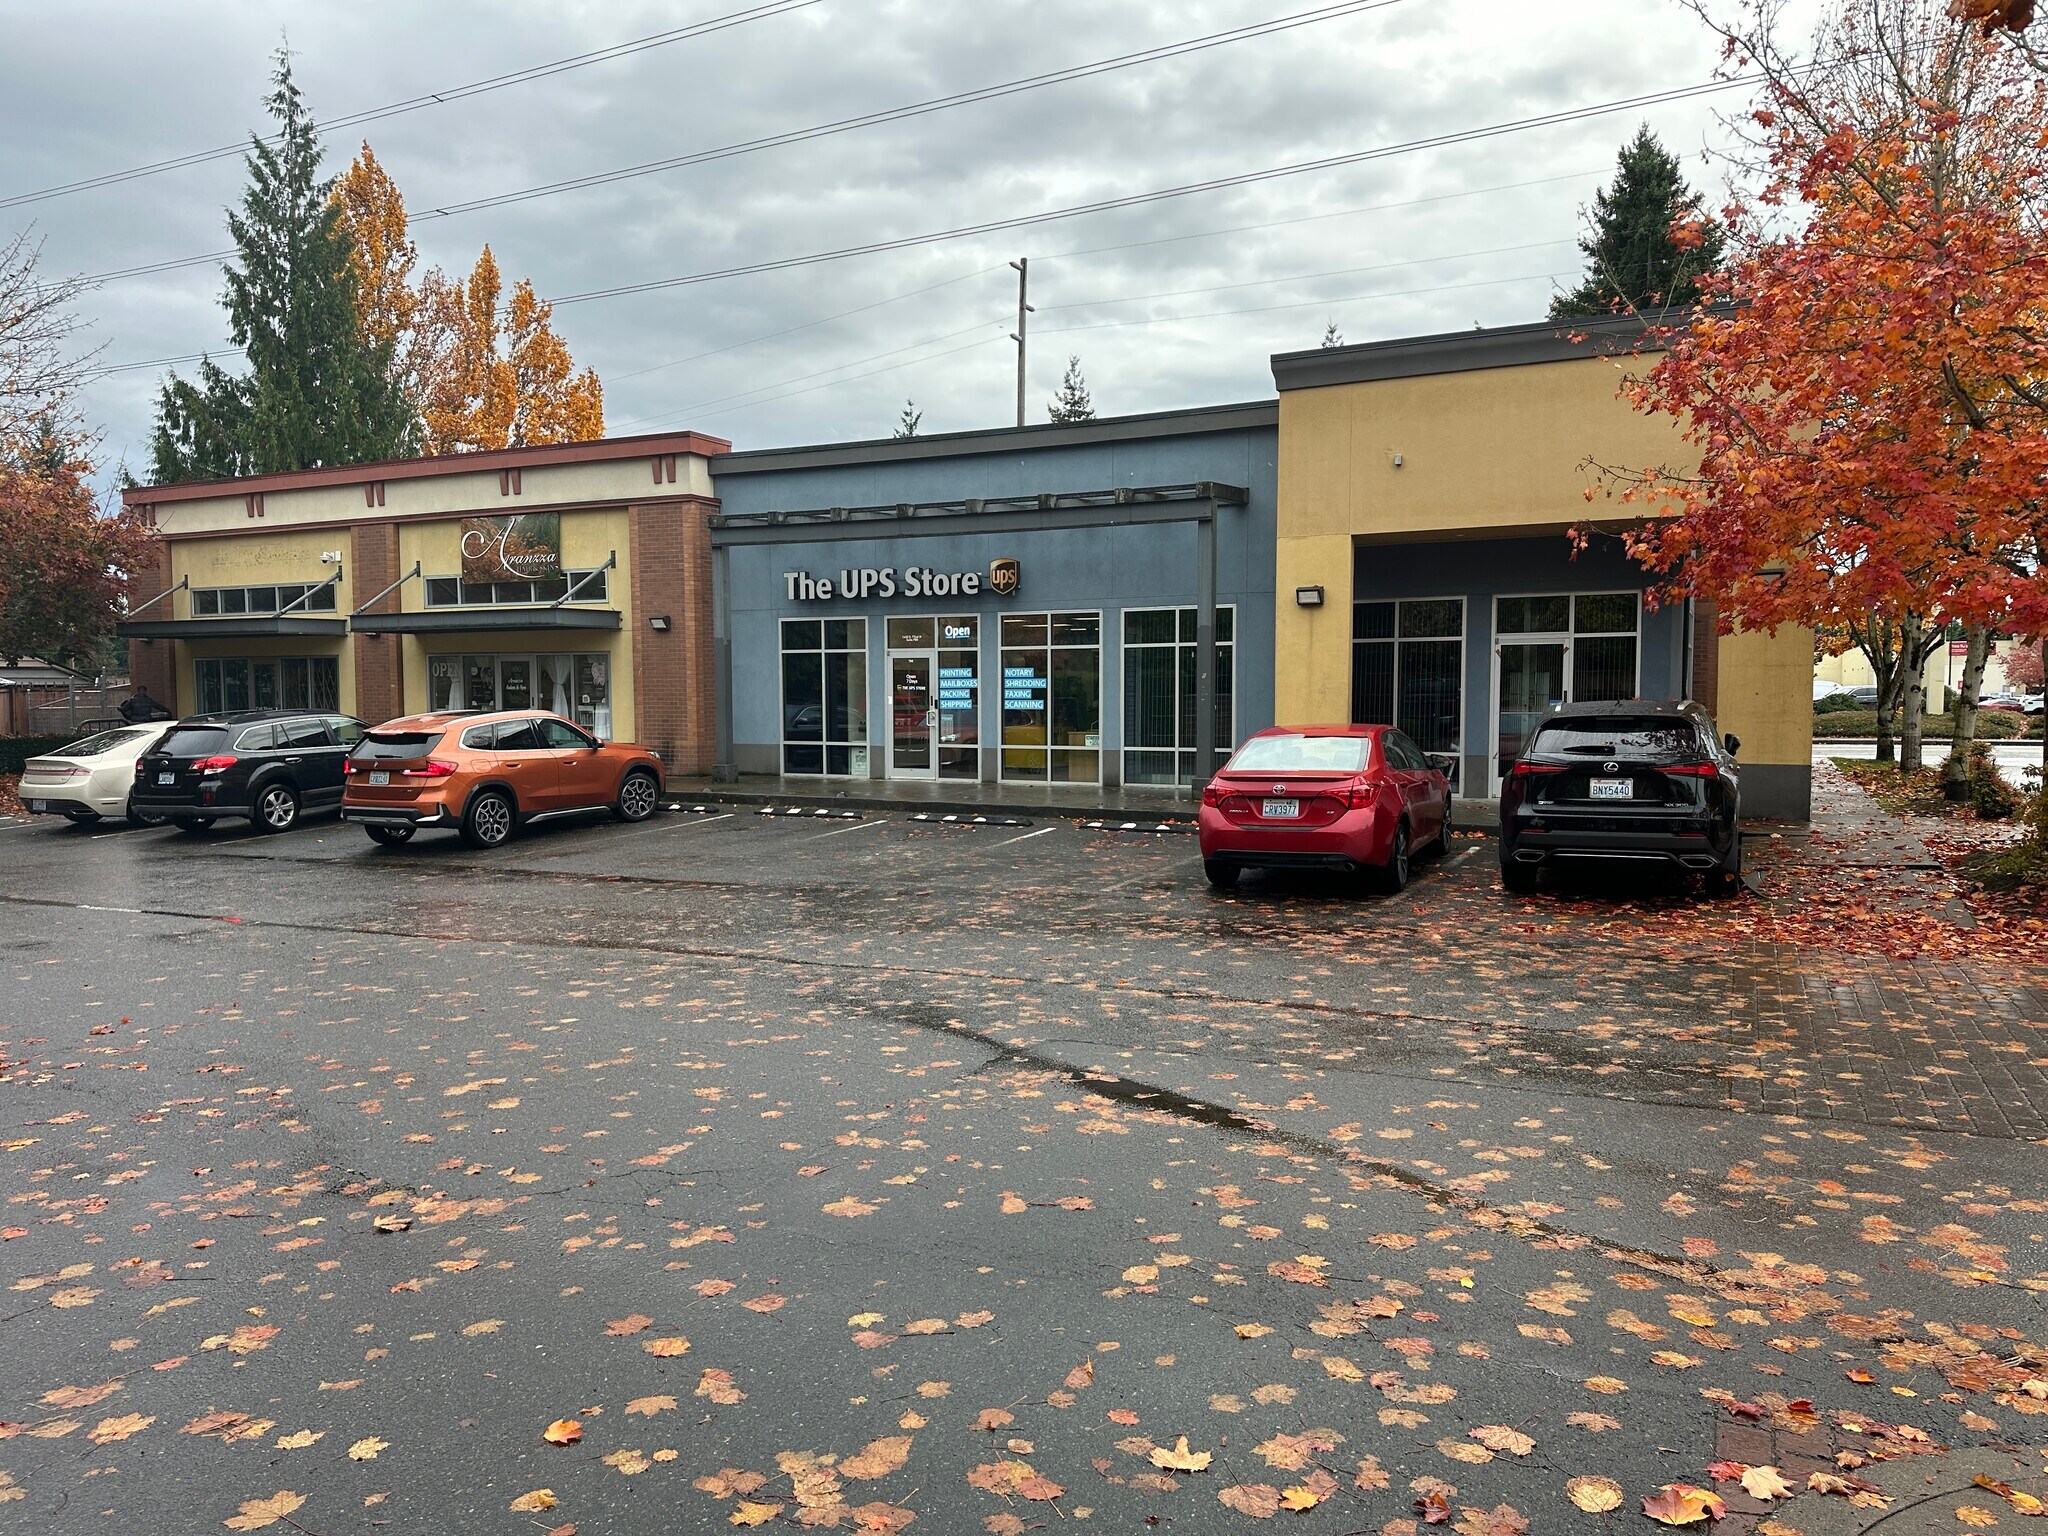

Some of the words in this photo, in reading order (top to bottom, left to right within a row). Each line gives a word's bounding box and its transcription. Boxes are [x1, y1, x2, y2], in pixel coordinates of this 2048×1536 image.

[461, 517, 557, 578] Aranzza
[784, 571, 833, 600] The
[840, 567, 898, 599] UPS
[904, 566, 981, 597] Store
[992, 568, 1016, 590] ups
[945, 625, 970, 639] Open
[432, 662, 460, 677] OPEN
[1004, 679, 1046, 687] SHREDDING
[1004, 690, 1031, 698] FAXING
[1592, 785, 1630, 796] BNY5440
[1264, 804, 1297, 815] CRV3977
